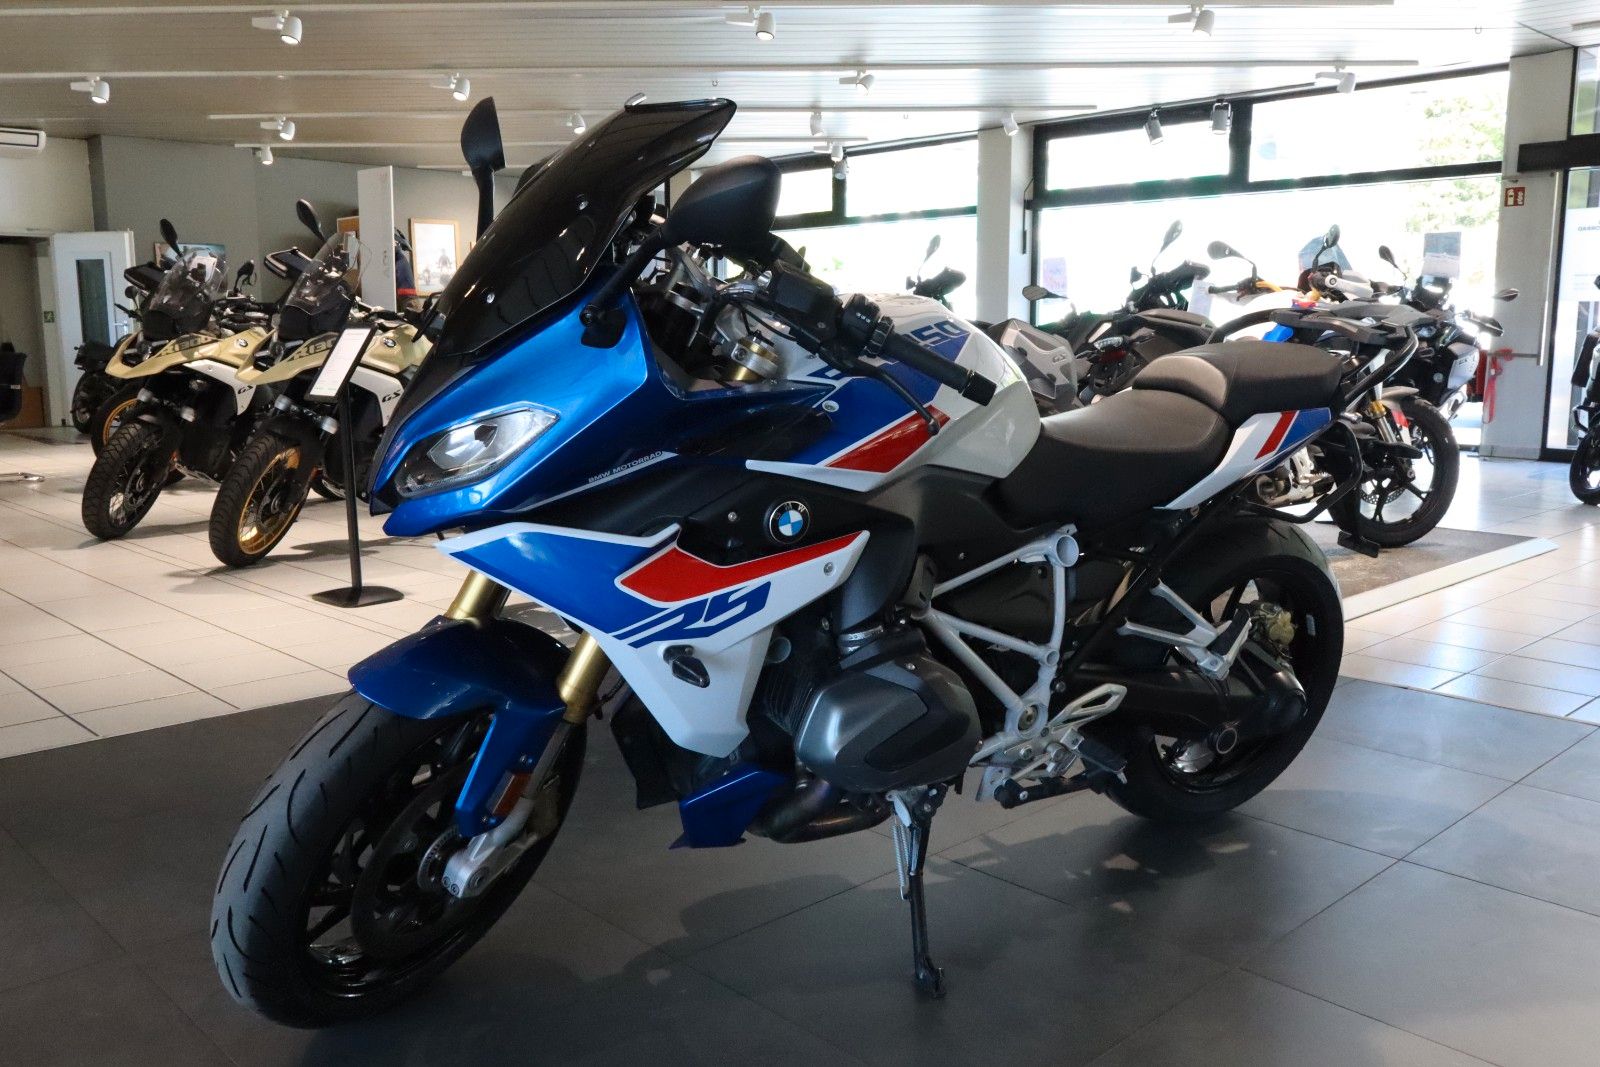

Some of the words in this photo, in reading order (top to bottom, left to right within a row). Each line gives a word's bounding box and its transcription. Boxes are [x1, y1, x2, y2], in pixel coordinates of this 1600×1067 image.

[382, 390, 401, 403] GS
[588, 470, 612, 483] BMW
[612, 450, 662, 475] MOTORRAD
[612, 581, 771, 649] RS
